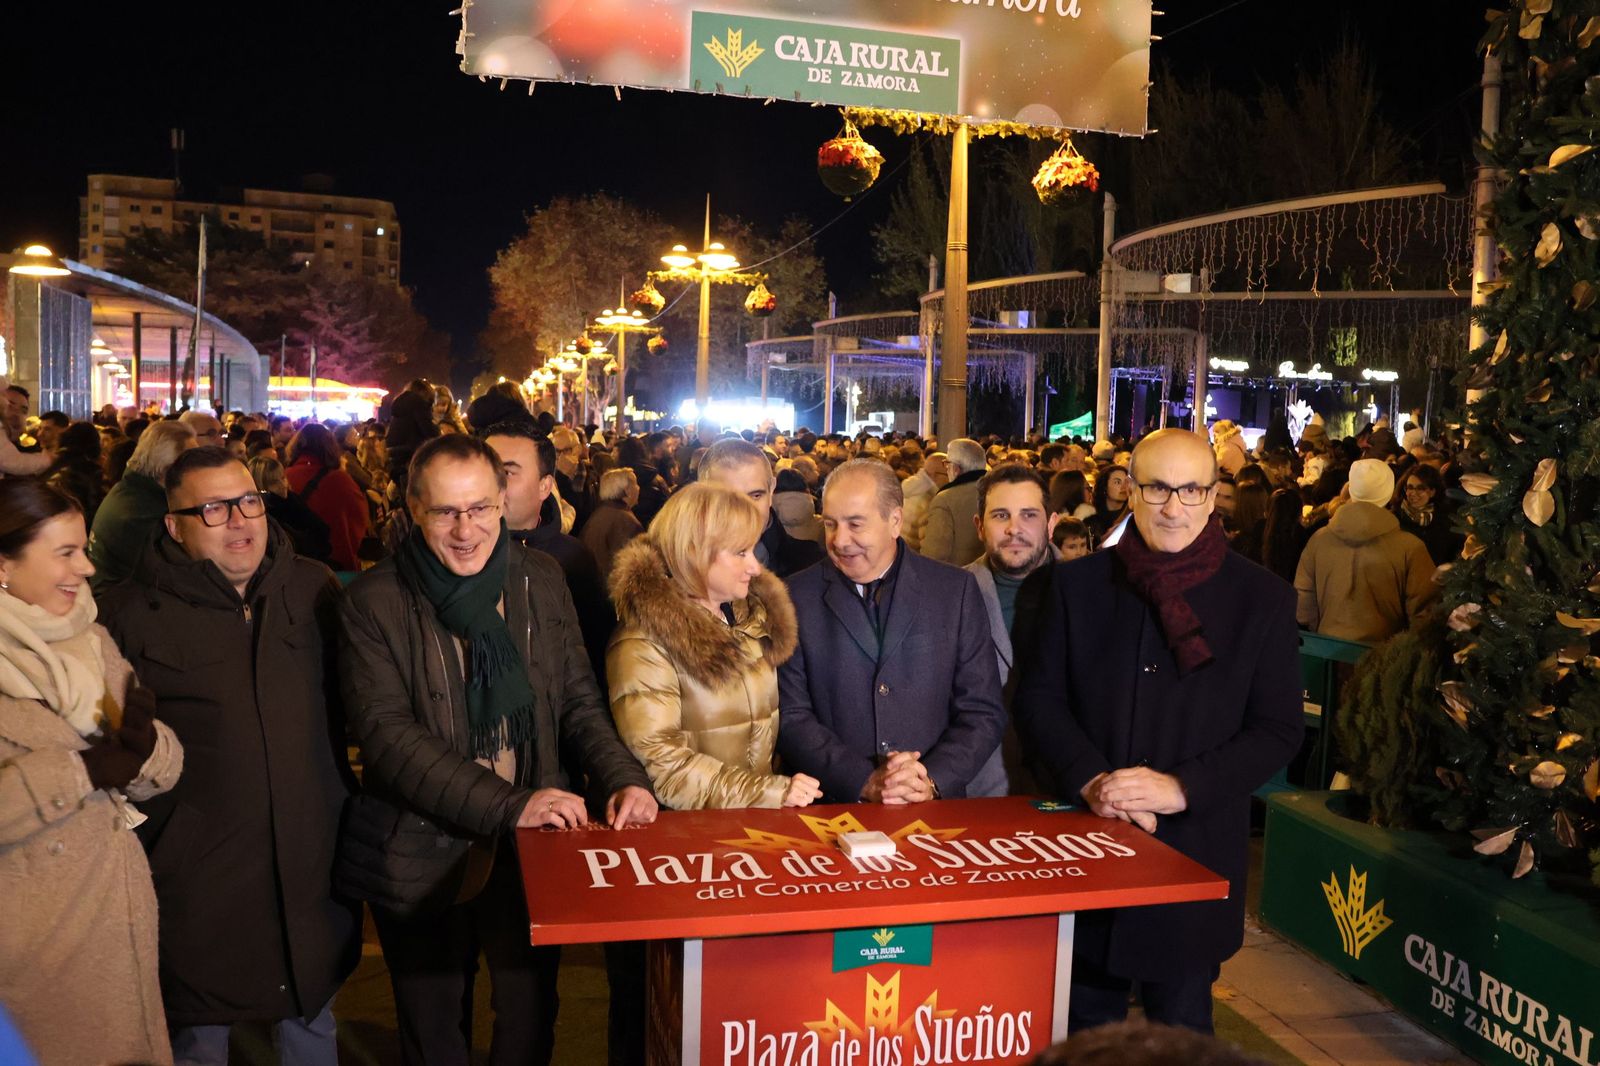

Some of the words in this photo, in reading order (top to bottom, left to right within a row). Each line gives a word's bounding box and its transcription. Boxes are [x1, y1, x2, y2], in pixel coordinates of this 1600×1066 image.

[774, 34, 847, 66] CAJA
[848, 42, 949, 77] RURAL
[808, 67, 832, 84] DE
[841, 71, 920, 93] ZAMORA
[577, 847, 773, 889] Plaza
[781, 849, 841, 878] de
[906, 830, 1137, 869] Sueños
[696, 883, 746, 900] del
[755, 876, 911, 897] Comercio
[919, 872, 958, 887] de
[962, 865, 1088, 884] Zamora
[860, 948, 879, 956] CAJA
[880, 946, 905, 955] RURAL
[1404, 934, 1475, 1001] CAJA
[1477, 970, 1600, 1066] RURAL
[1430, 985, 1456, 1018] DE
[722, 1019, 820, 1066] Plaza
[830, 1029, 861, 1066] de
[868, 1026, 903, 1066] los
[913, 1004, 1032, 1066] Sueños
